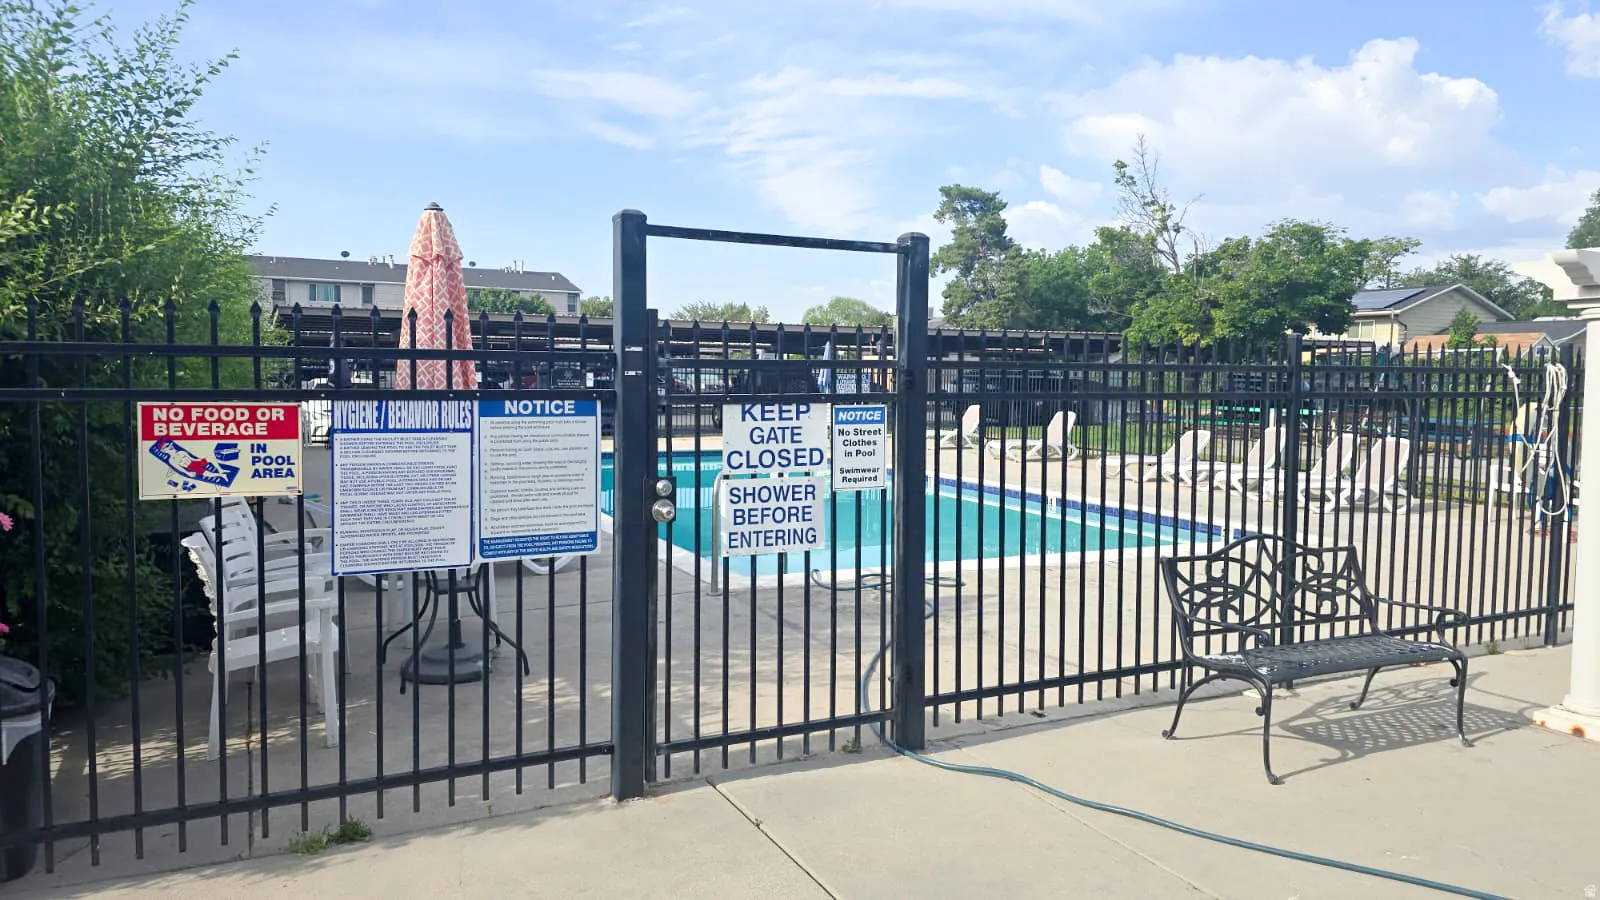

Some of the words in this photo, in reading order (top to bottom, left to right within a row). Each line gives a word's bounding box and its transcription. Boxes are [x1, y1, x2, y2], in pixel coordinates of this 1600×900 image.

[152, 407, 184, 421] NO
[191, 407, 249, 421] FOOD
[256, 407, 285, 421] OR
[334, 400, 379, 429] HYGIENE
[388, 400, 439, 429] BEHAVIOR
[441, 400, 472, 429] RULES
[504, 400, 576, 415] NOTICE
[741, 403, 811, 422] KEEP
[838, 410, 882, 421] NOTICE
[153, 422, 268, 437] BEVERAGE
[749, 426, 803, 445] GATE
[838, 428, 850, 436] No
[853, 427, 882, 436] Street
[250, 443, 267, 453] IN
[842, 439, 877, 447] Clothes
[726, 448, 825, 470] CLOSED
[844, 449, 852, 457] in
[855, 449, 876, 457] Pool
[251, 455, 295, 466] POOL
[251, 468, 295, 479] AREA
[840, 467, 880, 475] Swimwear
[841, 475, 878, 484] Required
[729, 484, 816, 505] SHOWER
[733, 505, 813, 526] BEFORE
[728, 527, 817, 549] ENTERING
